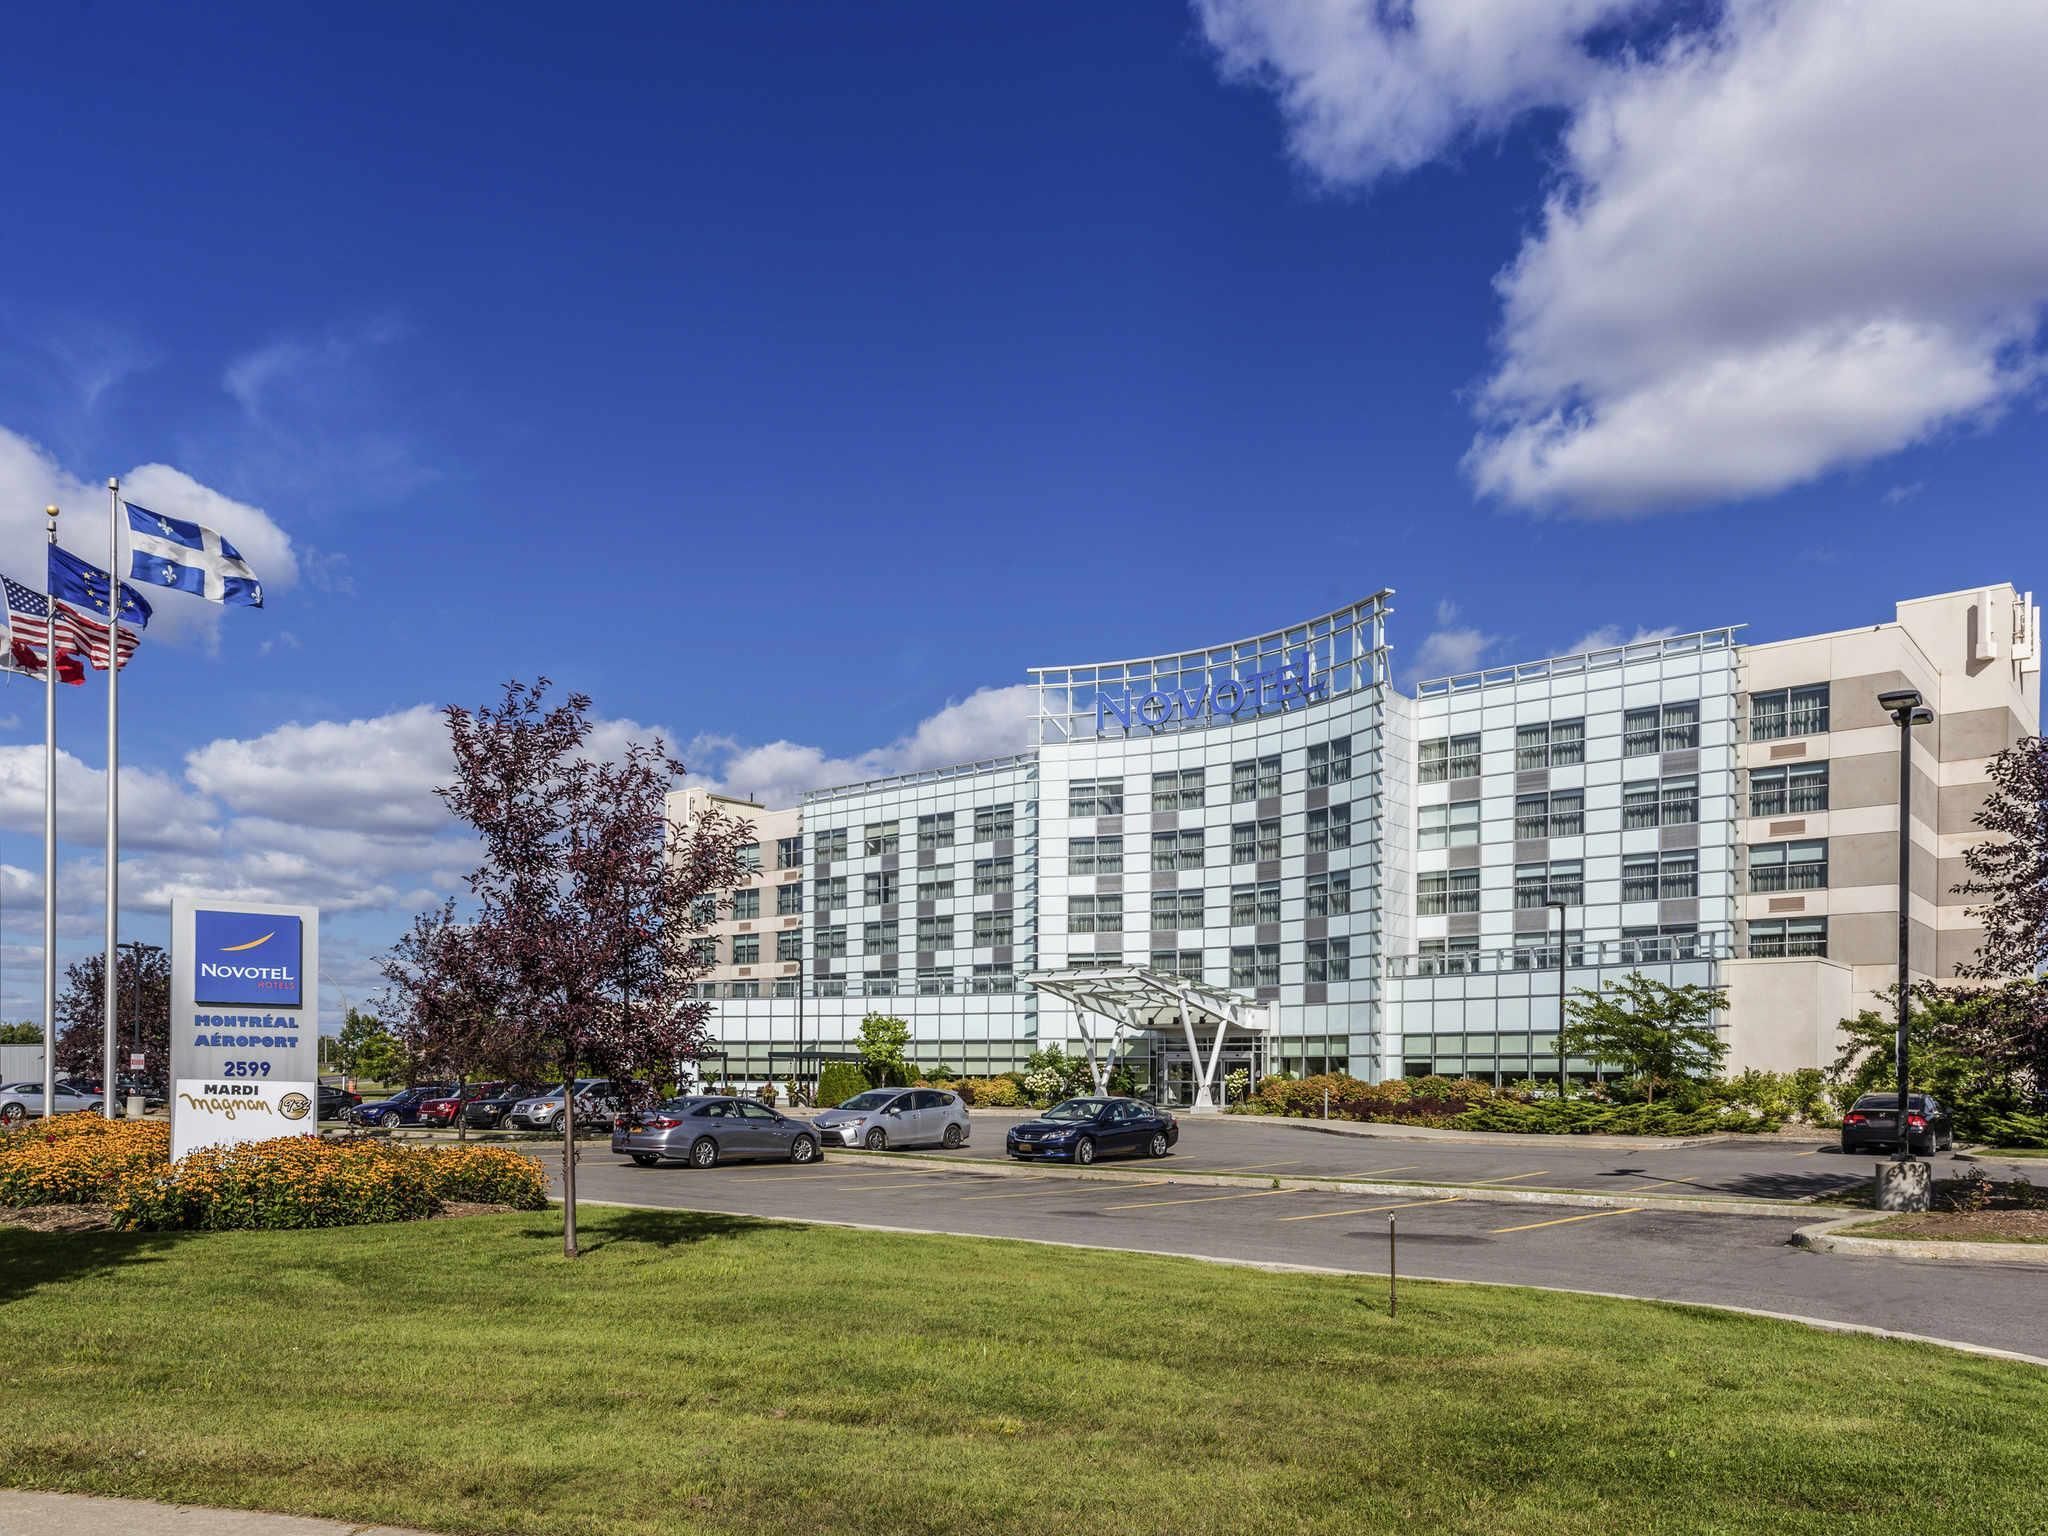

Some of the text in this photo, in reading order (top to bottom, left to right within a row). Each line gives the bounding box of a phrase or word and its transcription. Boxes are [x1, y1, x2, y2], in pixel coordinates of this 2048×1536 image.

[1096, 651, 1326, 734] NOVOTEL
[201, 963, 294, 980] NOVOTEL
[257, 981, 295, 990] HOTELS
[194, 1014, 299, 1028] MONTRÉAL
[194, 1032, 298, 1048] AÉROPORT
[224, 1061, 271, 1077] 2599
[204, 1084, 259, 1096] MARDI
